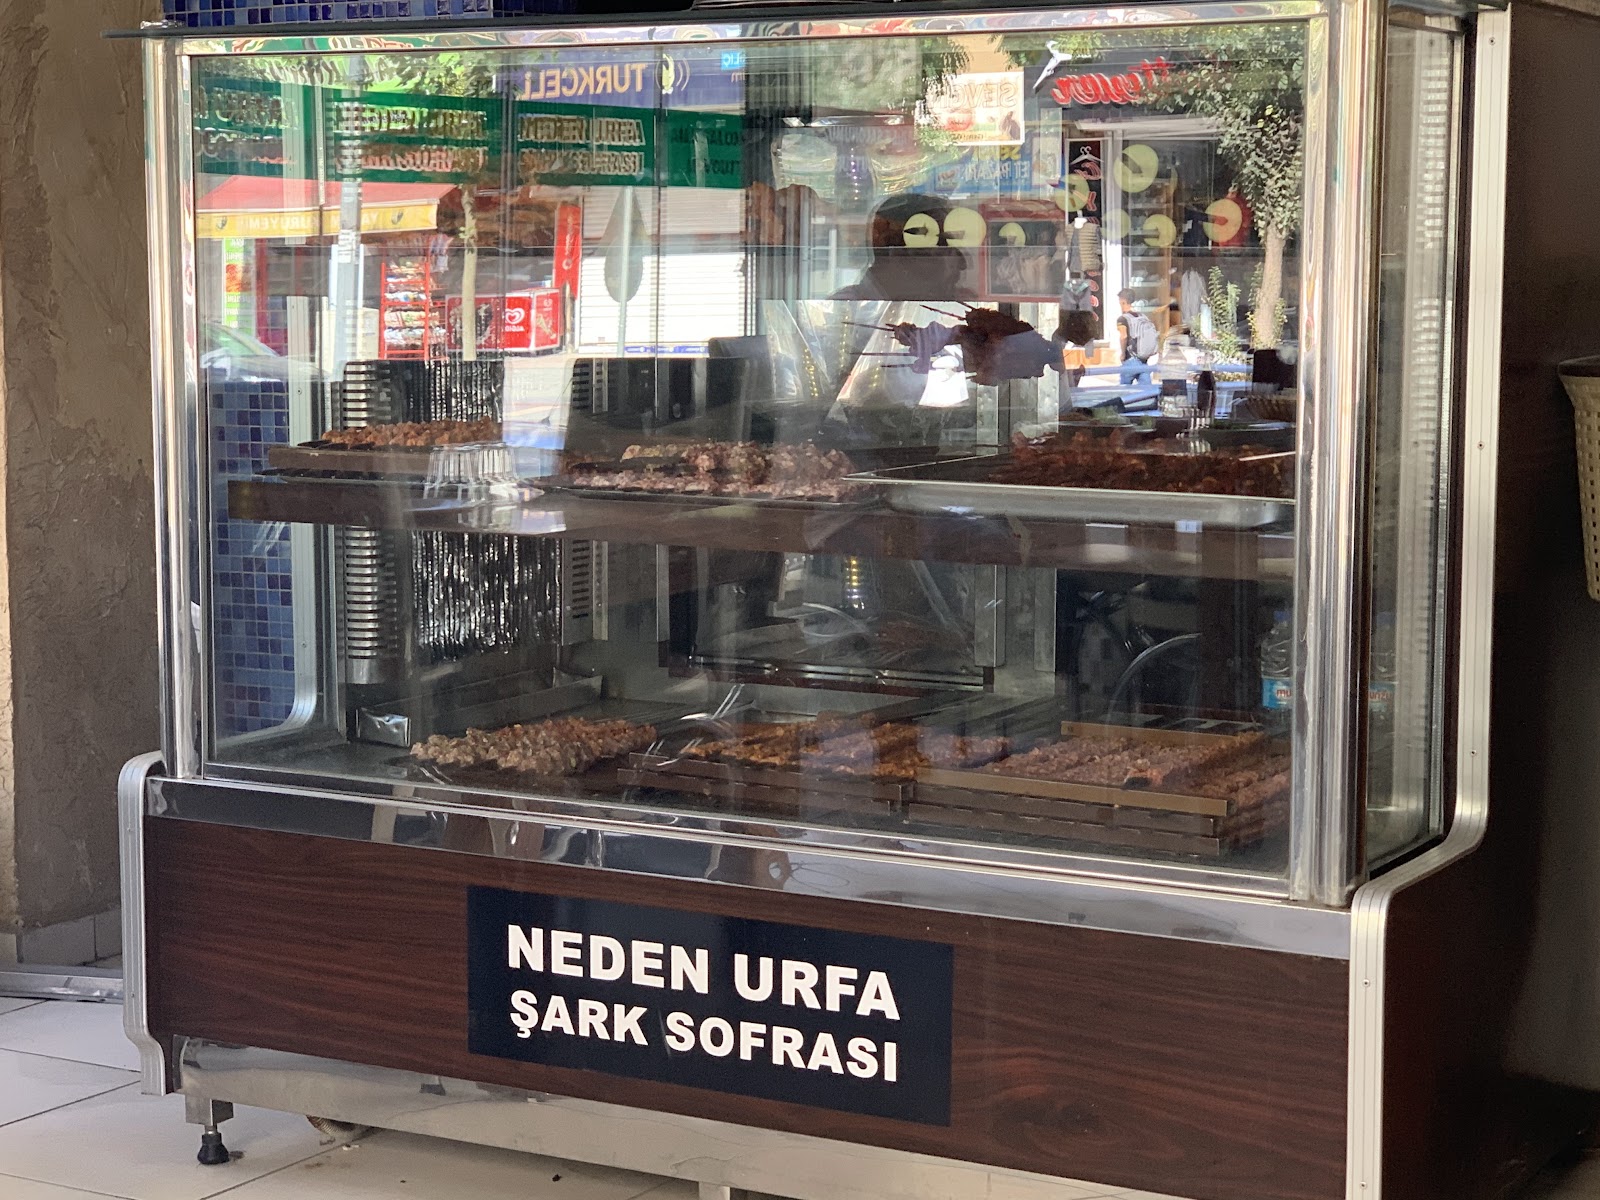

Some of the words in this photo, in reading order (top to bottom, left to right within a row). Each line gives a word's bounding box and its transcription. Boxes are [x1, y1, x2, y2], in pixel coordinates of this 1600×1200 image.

[508, 924, 709, 994] NEDEN
[733, 953, 901, 1020] URFA
[510, 989, 649, 1045] ŞARK
[665, 1011, 897, 1082] SOFRASI
